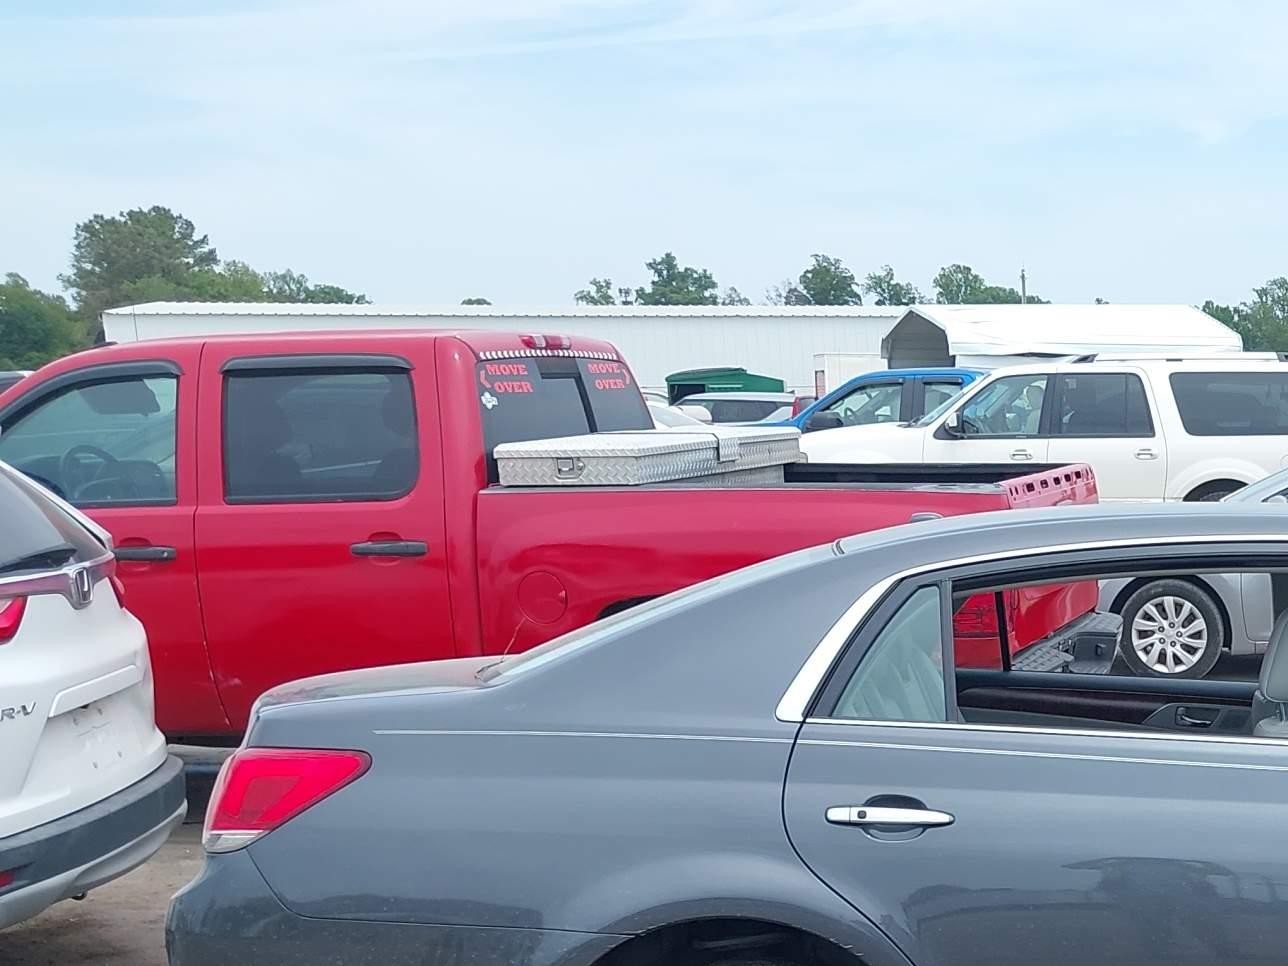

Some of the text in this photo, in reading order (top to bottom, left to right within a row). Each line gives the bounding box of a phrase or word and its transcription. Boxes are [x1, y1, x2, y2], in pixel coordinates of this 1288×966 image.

[486, 363, 529, 376] MOVE
[587, 363, 621, 374] MOVE
[494, 380, 533, 393] OVER
[595, 379, 625, 389] OVER
